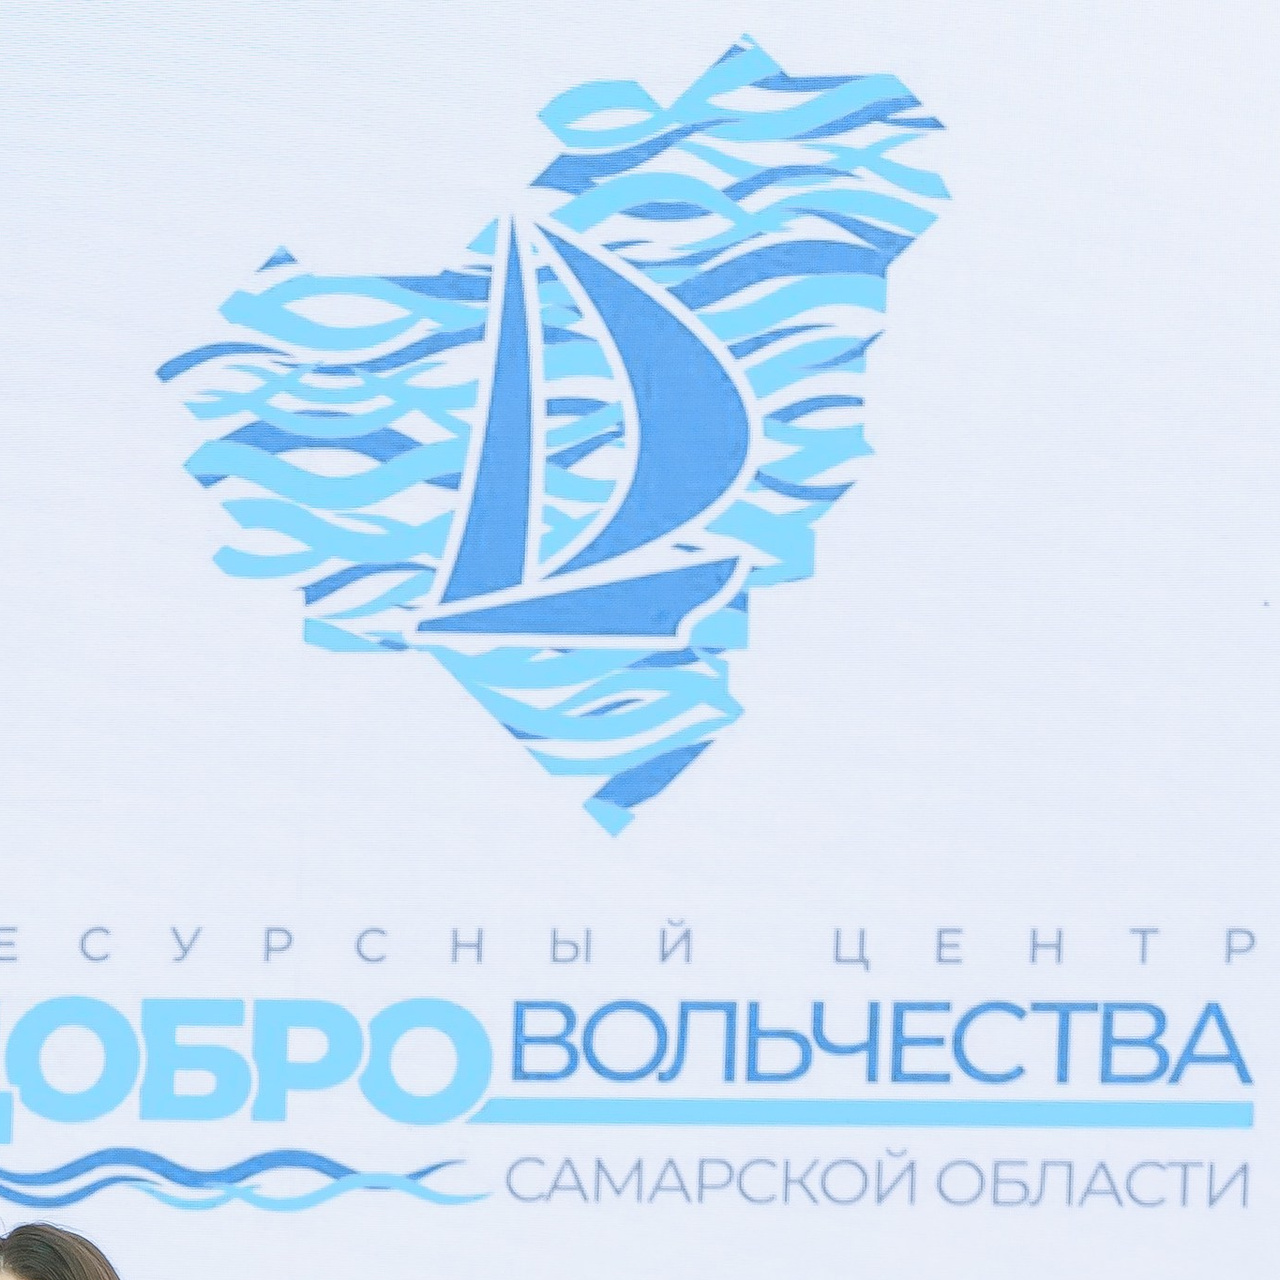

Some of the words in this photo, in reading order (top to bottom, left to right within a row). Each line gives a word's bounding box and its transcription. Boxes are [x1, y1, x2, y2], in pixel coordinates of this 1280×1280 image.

[833, 926, 1256, 972] ЦЕНТР
[505, 1148, 917, 1206] САМАРСКОЙ
[936, 1160, 1250, 1209] ОБЛАСТИ
